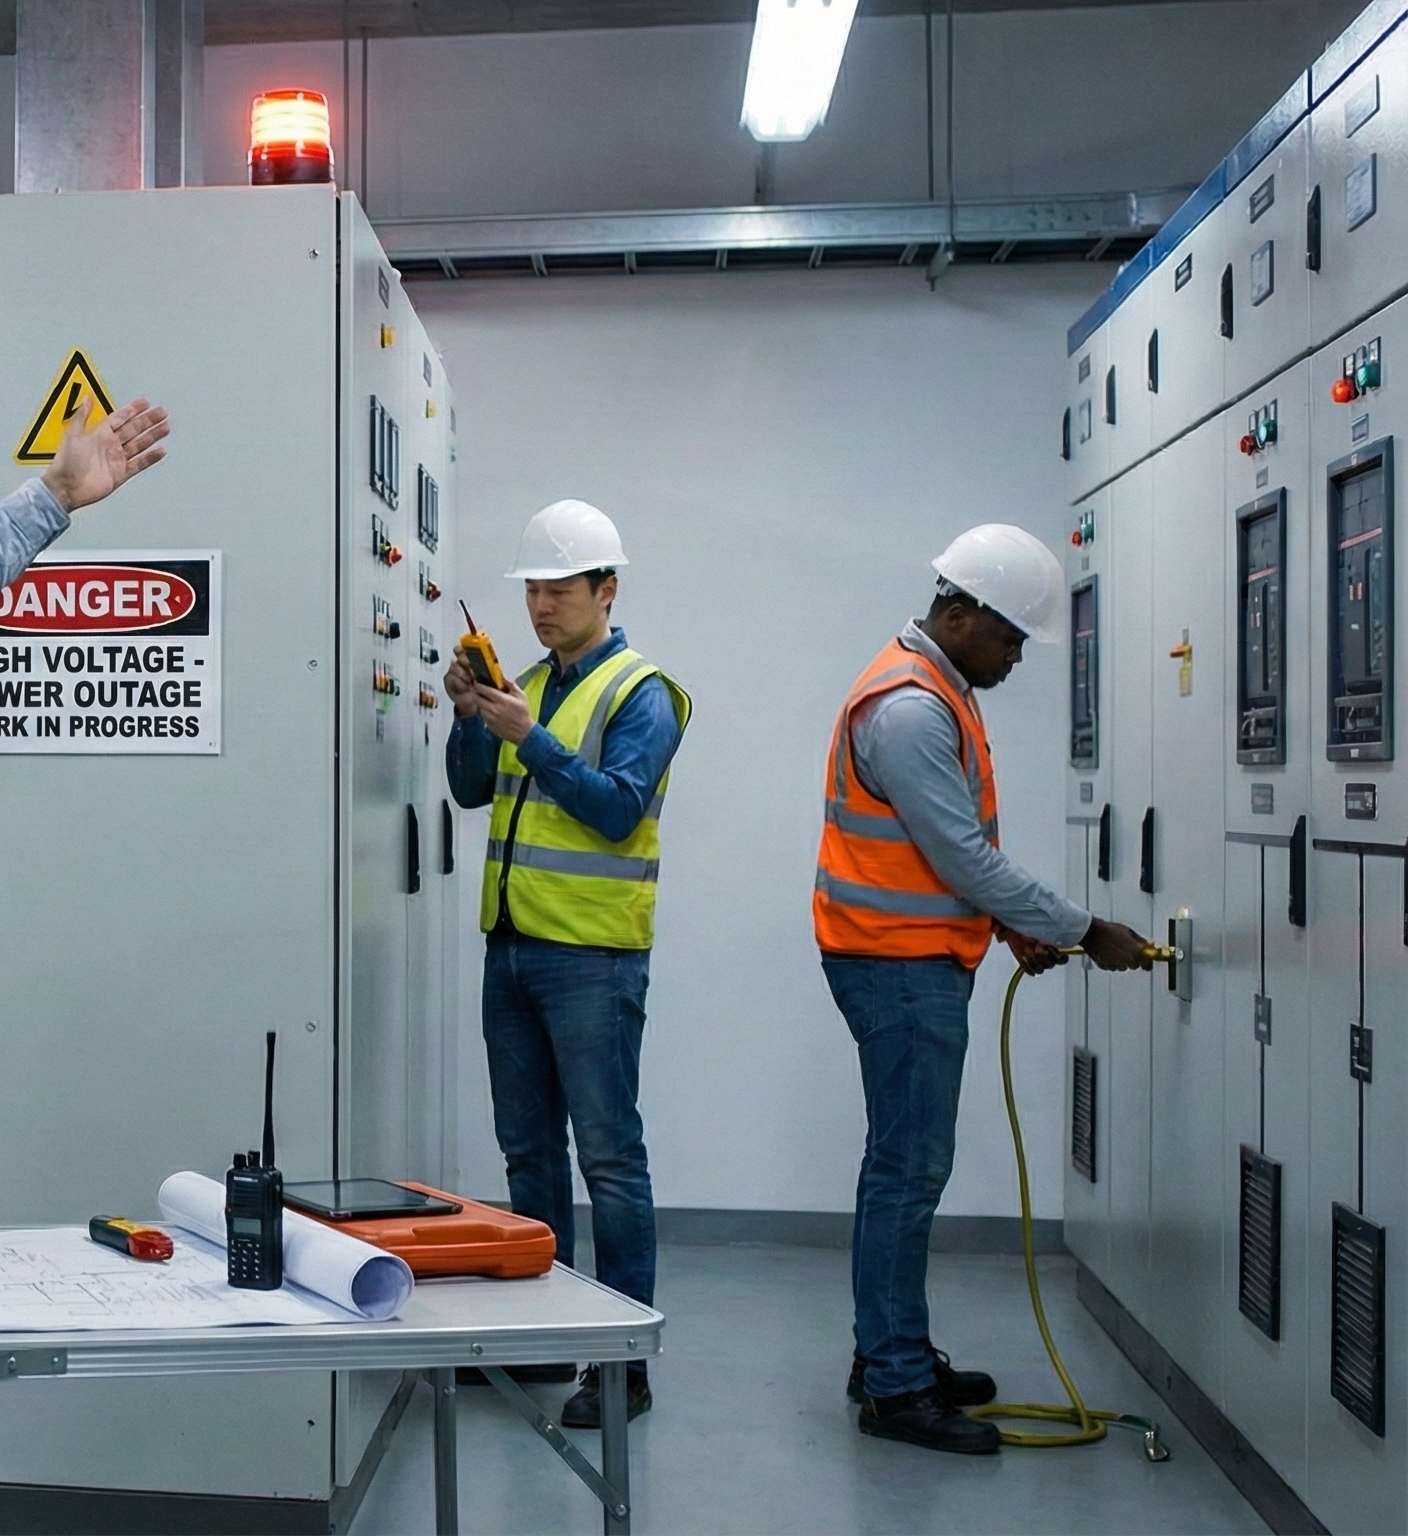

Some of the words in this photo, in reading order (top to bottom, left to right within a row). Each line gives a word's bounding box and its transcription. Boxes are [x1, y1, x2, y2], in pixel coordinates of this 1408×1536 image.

[42, 646, 185, 674] VOLTAGE
[73, 681, 202, 708] OUTAGE
[36, 715, 61, 738] IN
[69, 715, 200, 738] PROGRESS
